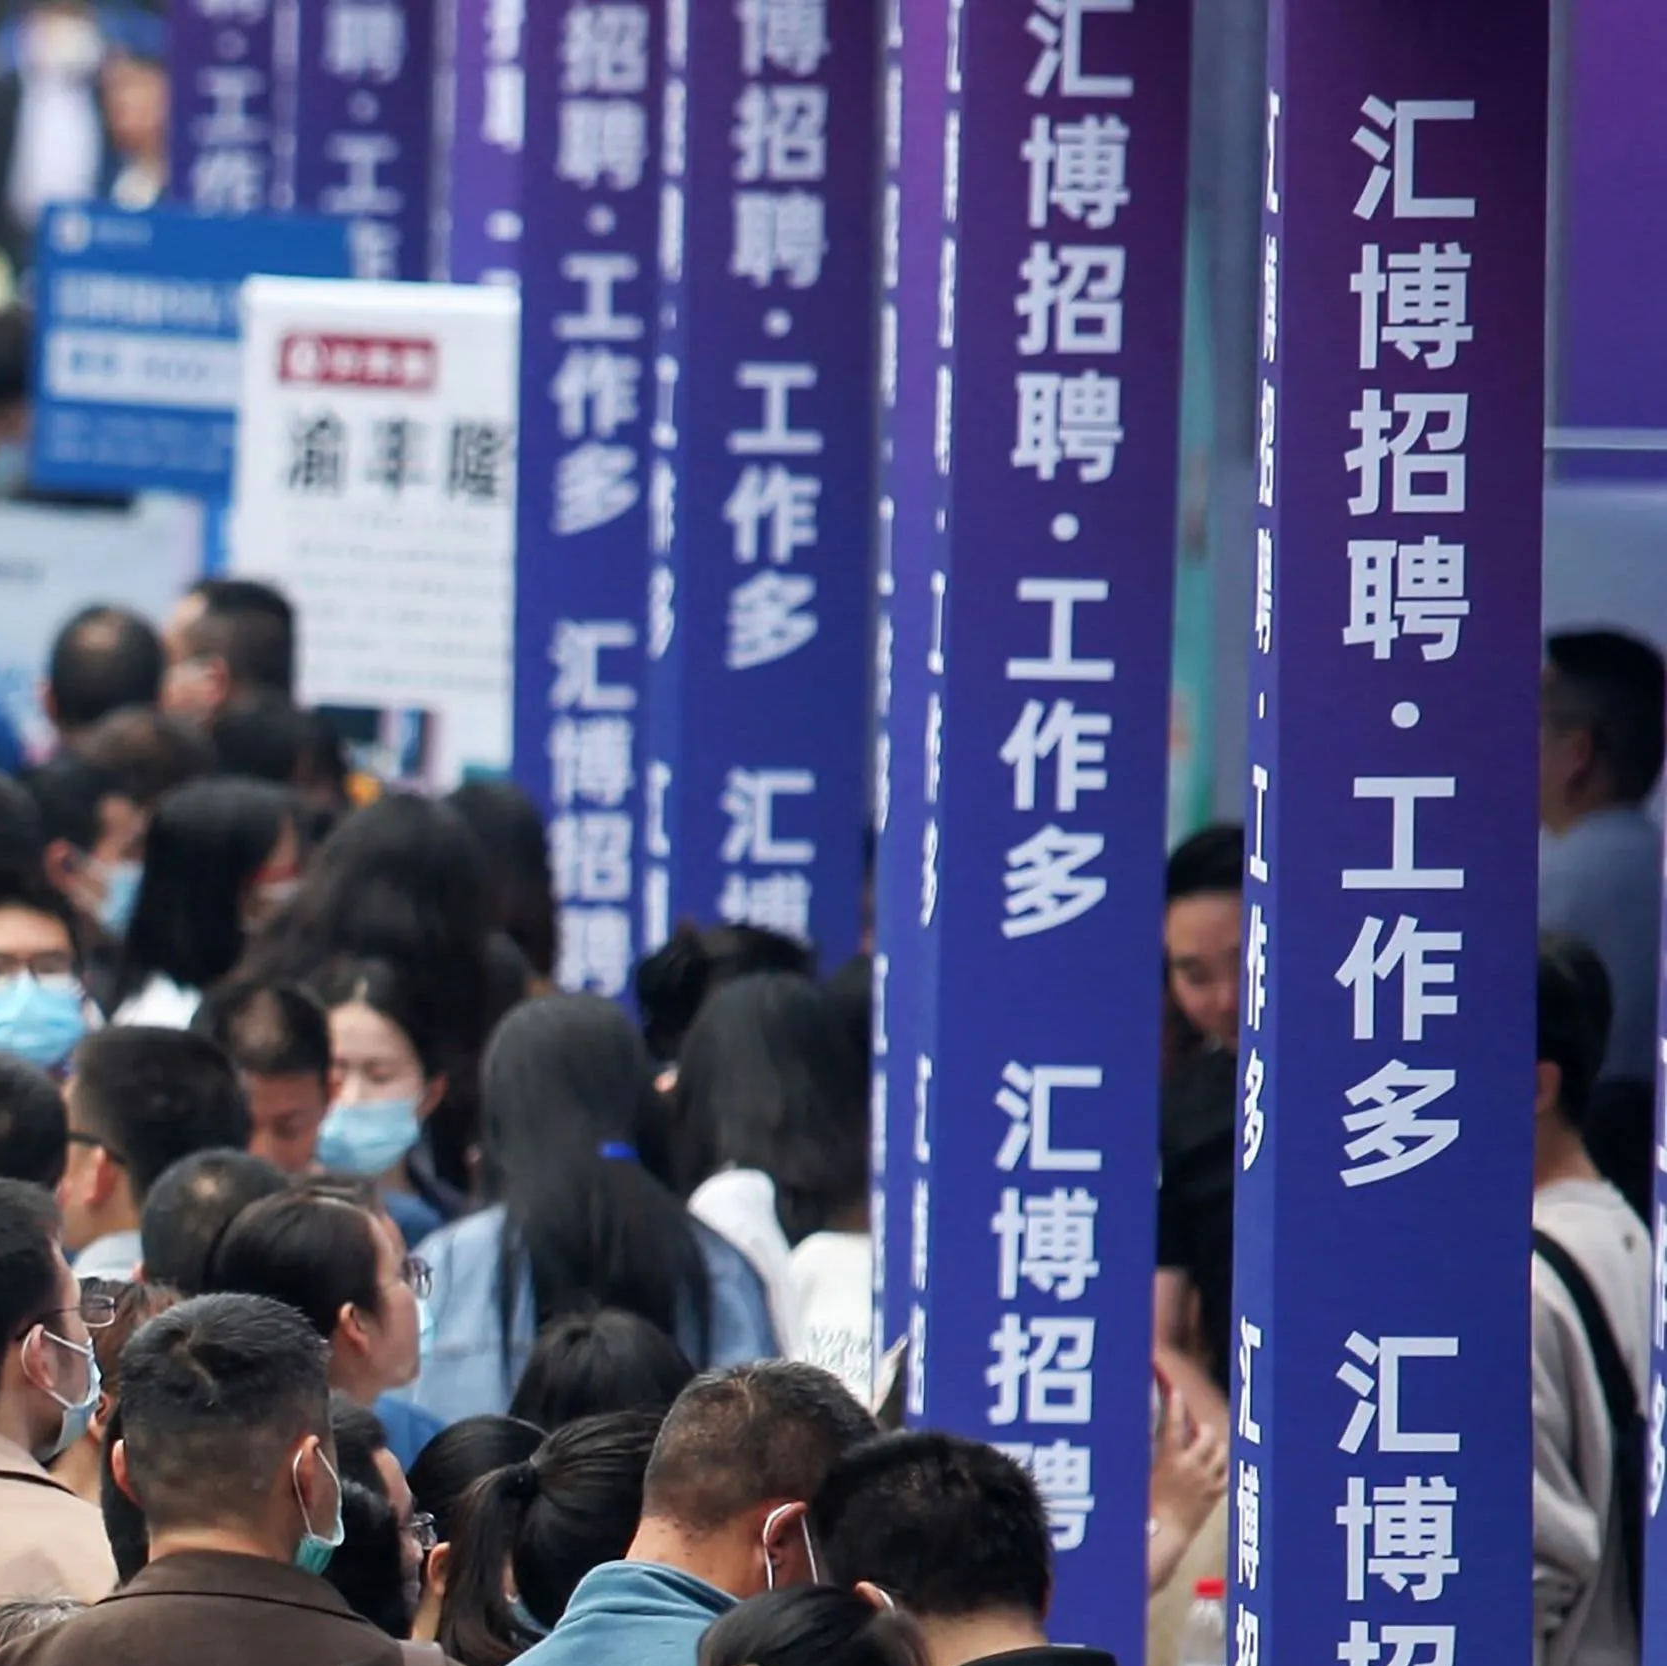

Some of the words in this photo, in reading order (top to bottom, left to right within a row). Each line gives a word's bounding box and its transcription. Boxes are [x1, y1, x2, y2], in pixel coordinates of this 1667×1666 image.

[999, 0, 1134, 939] 汇博招聘·工作多
[1335, 95, 1475, 1187] 汇博招聘·工作多
